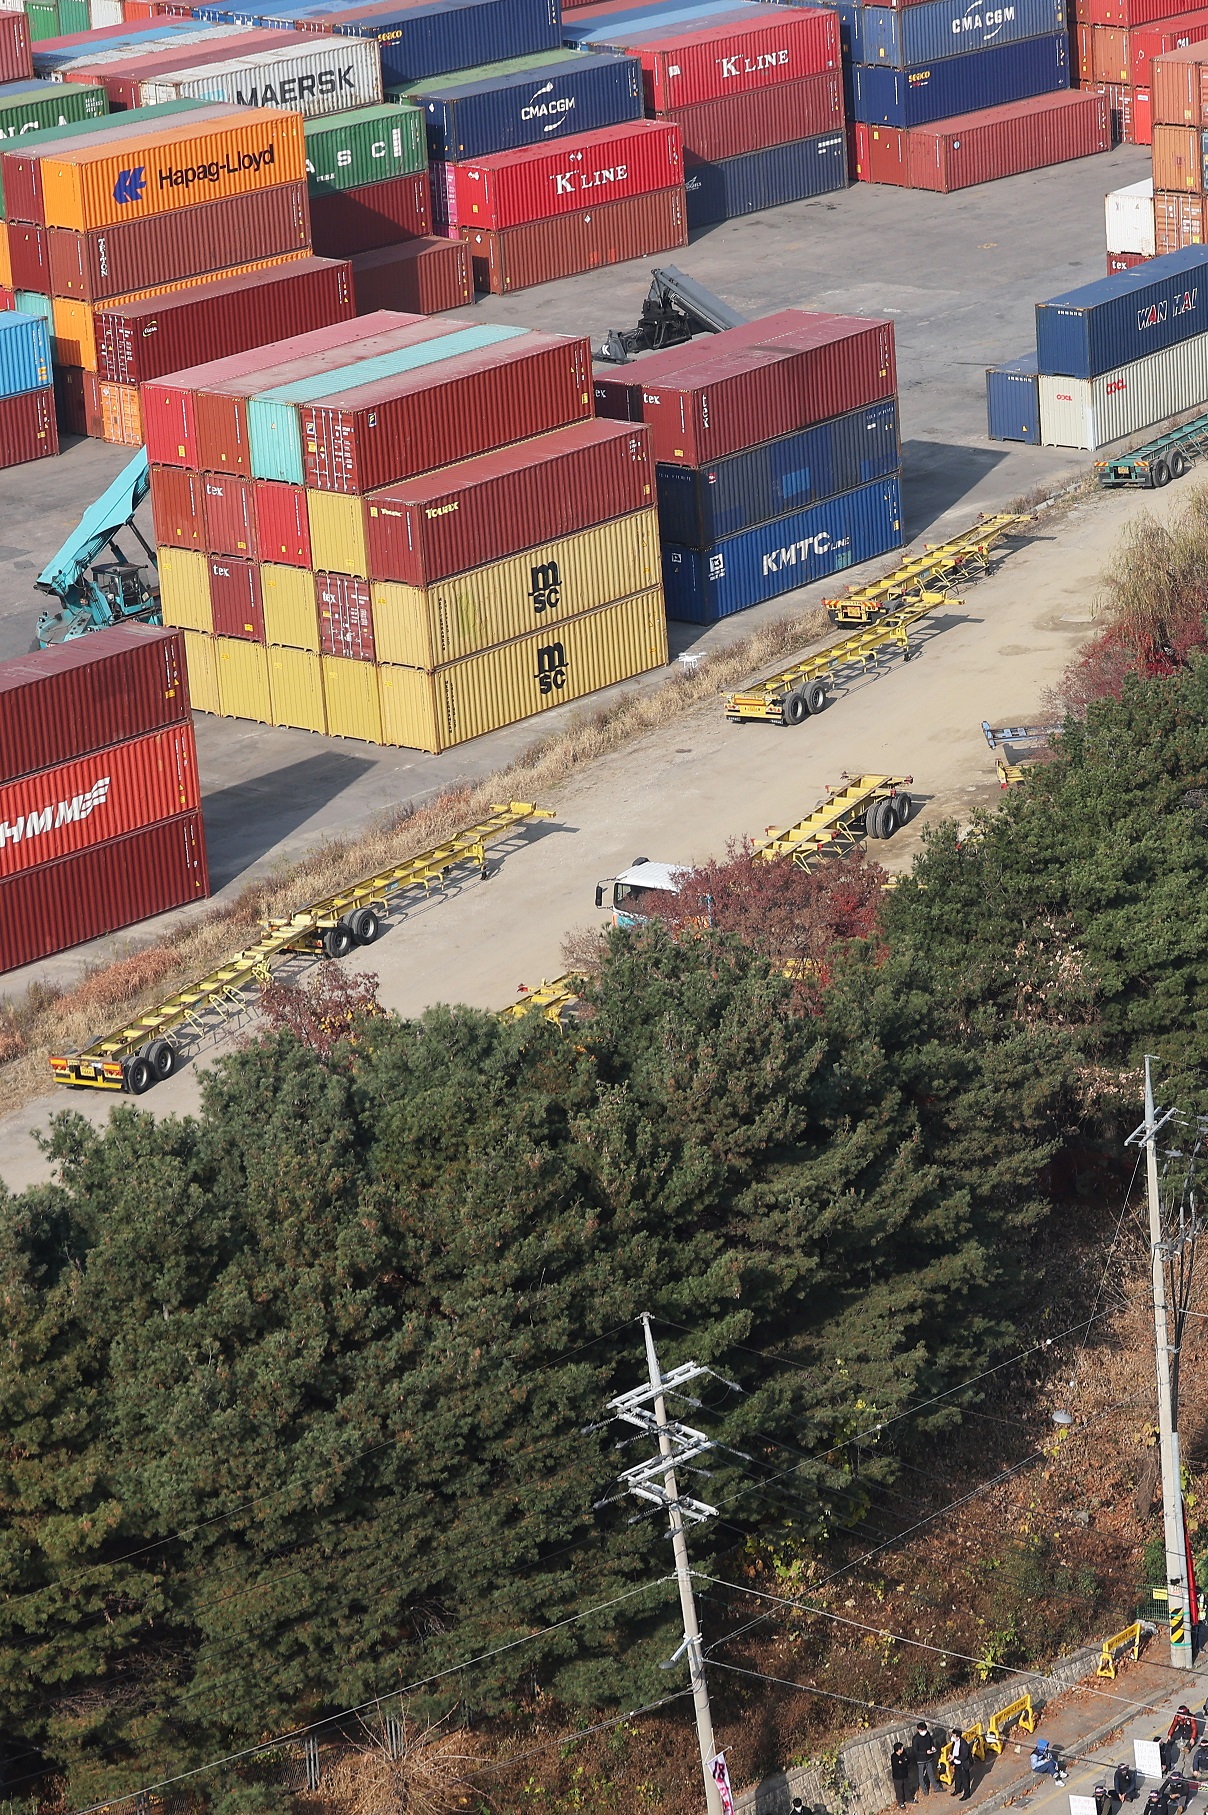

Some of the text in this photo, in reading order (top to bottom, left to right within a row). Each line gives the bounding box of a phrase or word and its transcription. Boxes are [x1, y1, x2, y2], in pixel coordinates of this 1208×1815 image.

[951, 7, 1015, 34] CMA CGM
[744, 49, 789, 73] LINE
[237, 65, 356, 107] MAERSK
[521, 97, 576, 121] CMA CGM
[158, 143, 275, 190] Hapag-Lloyd
[581, 165, 628, 189] LINE
[1111, 260, 1128, 270] tex
[1138, 300, 1168, 332] WAN
[643, 392, 661, 405] tex
[702, 394, 710, 430] tex
[206, 483, 224, 497] tex
[762, 532, 830, 576] KMTC
[213, 564, 231, 578] tex
[322, 590, 337, 604] tex
